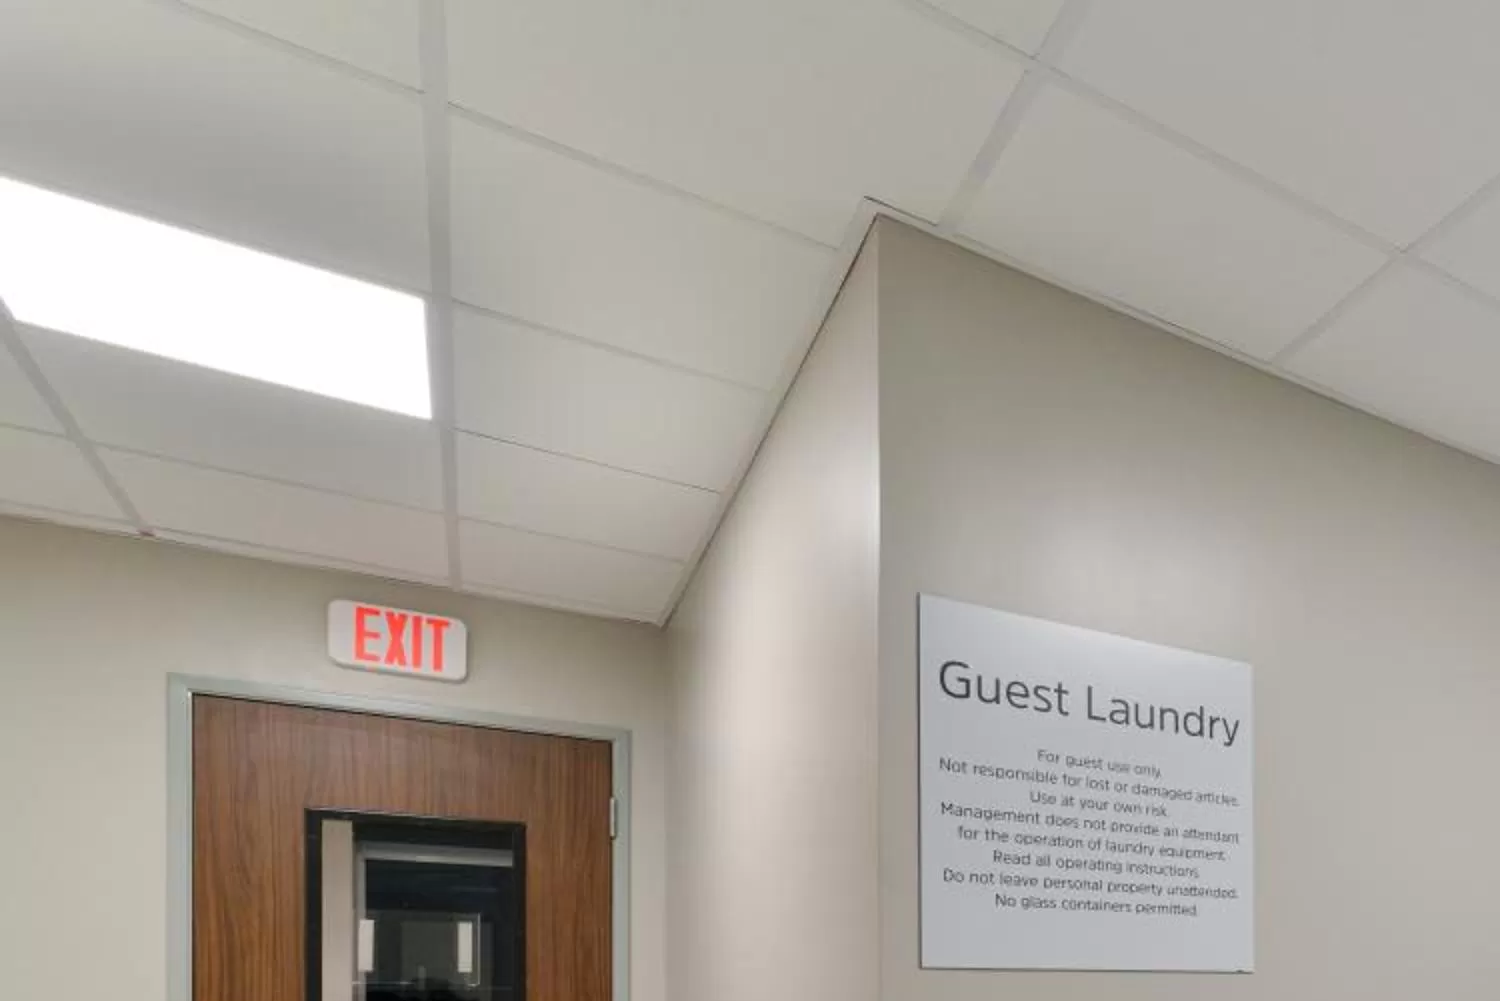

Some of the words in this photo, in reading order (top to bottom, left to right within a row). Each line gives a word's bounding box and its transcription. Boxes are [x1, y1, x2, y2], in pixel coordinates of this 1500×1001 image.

[355, 606, 450, 672] EXIT
[939, 660, 1069, 716] Guest
[1086, 685, 1240, 747] Laundry
[1037, 749, 1060, 766] For
[1066, 756, 1103, 771] guest
[1108, 761, 1131, 773] use
[939, 756, 968, 774] Not
[973, 764, 1058, 785] responsible
[1062, 773, 1082, 787] for
[1085, 775, 1109, 792] lost
[1113, 781, 1128, 793] or
[1131, 783, 1193, 801] damaged
[1030, 791, 1057, 805] Use
[1061, 794, 1075, 807] at
[1079, 798, 1110, 812] your
[1113, 801, 1142, 814] own
[941, 801, 1041, 825] Management
[1045, 812, 1079, 829] does
[1083, 818, 1106, 831] not
[1110, 820, 1160, 837] provide
[1164, 826, 1179, 838] an
[1182, 828, 1239, 845] attendant
[957, 825, 980, 841] for
[984, 827, 1009, 843] the
[1014, 831, 1083, 850] operation
[1087, 838, 1102, 851] of
[1105, 839, 1155, 857] laundry
[993, 849, 1031, 866] Read
[1035, 853, 1051, 868] all
[1055, 857, 1122, 876] operating
[943, 868, 966, 883] Do
[968, 870, 995, 886] not
[999, 871, 1039, 887] leave
[1043, 875, 1103, 893] personal
[1107, 881, 1163, 898] property
[1167, 885, 1239, 900] unattended.
[994, 893, 1017, 909] No
[1020, 894, 1057, 912] glass
[1061, 896, 1132, 914] containers
